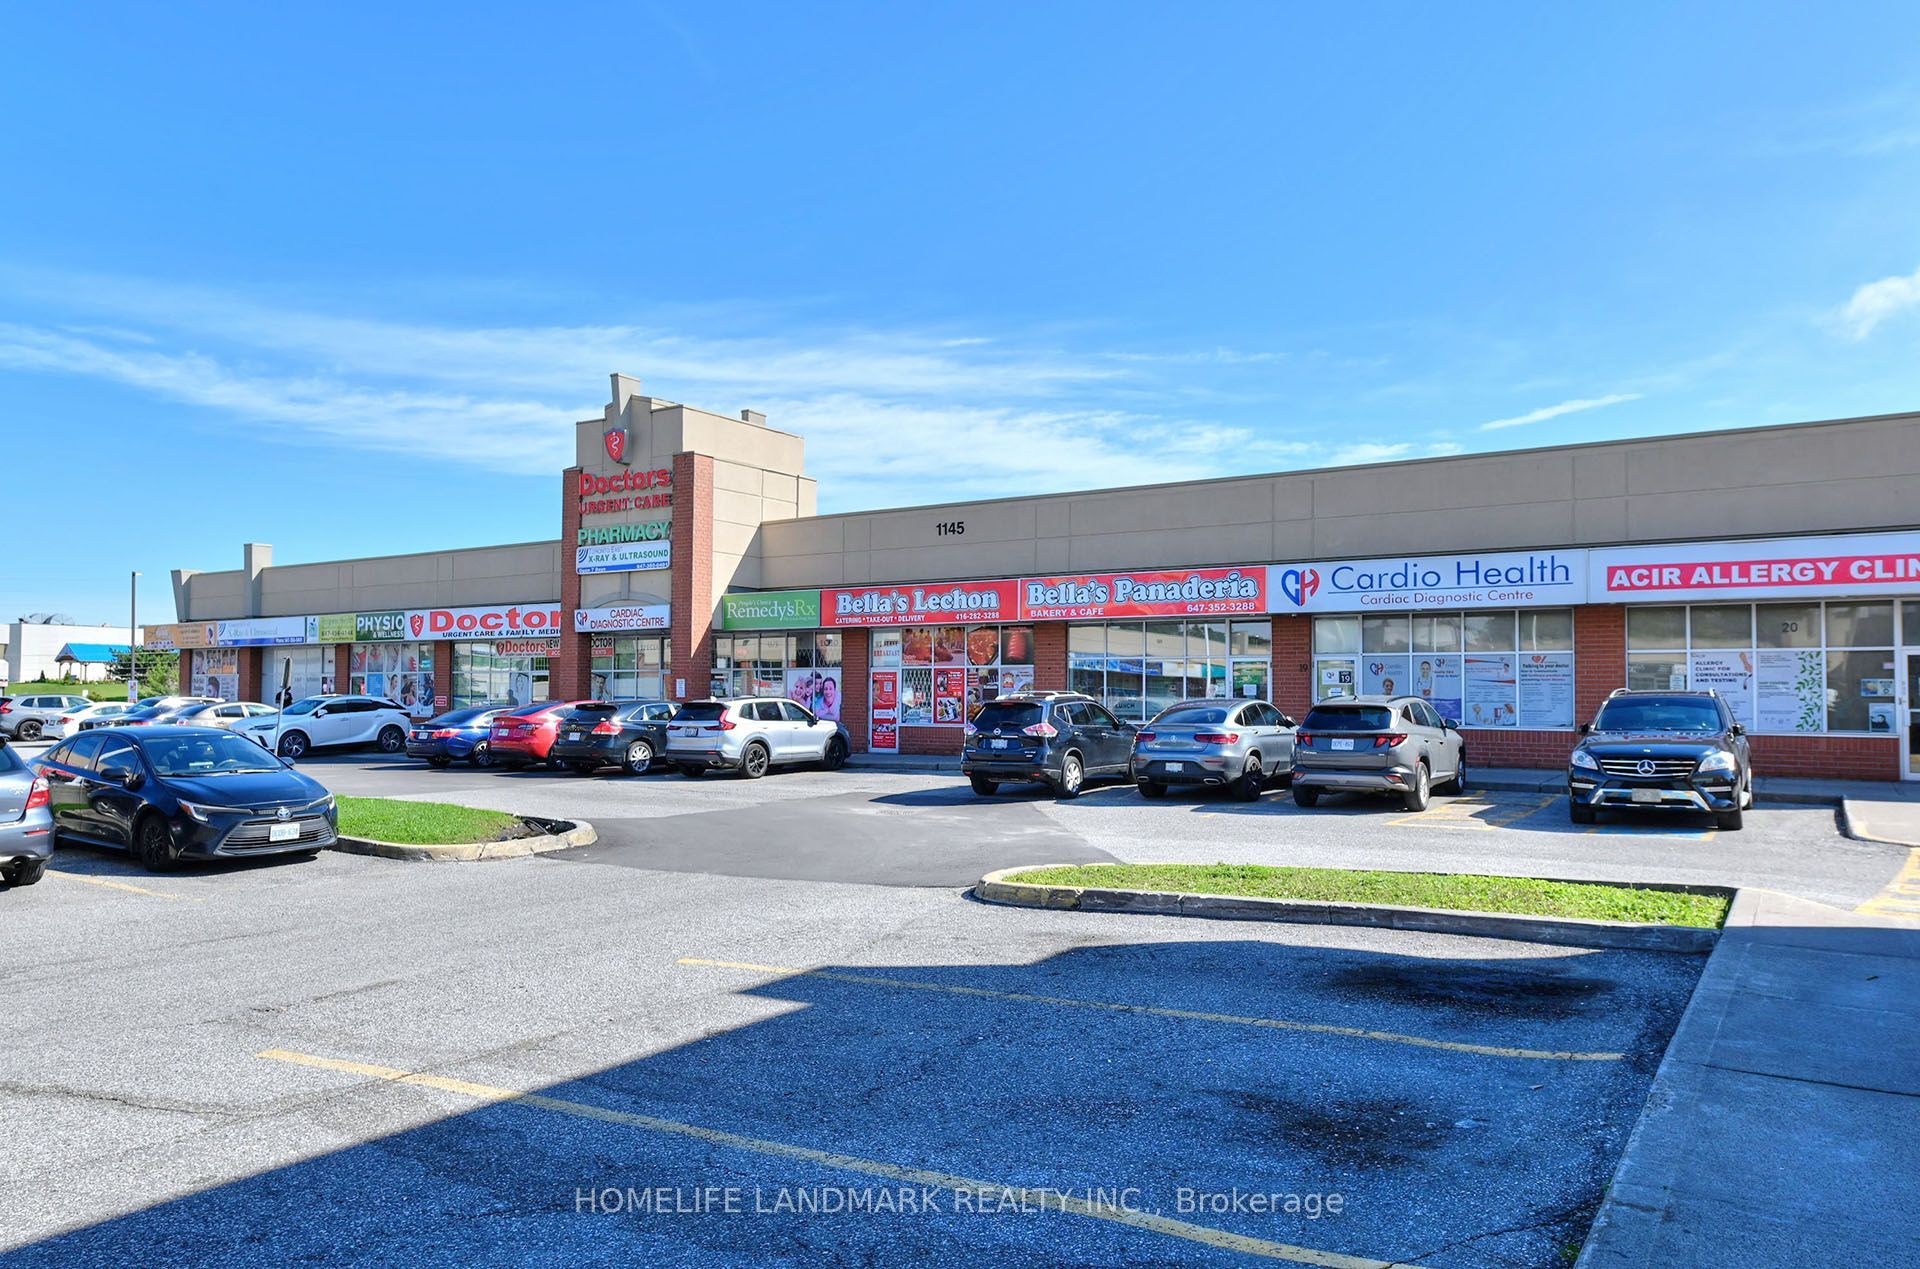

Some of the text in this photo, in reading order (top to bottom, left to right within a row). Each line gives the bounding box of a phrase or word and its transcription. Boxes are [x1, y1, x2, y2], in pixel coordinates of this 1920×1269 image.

[579, 468, 672, 496] Doctors
[579, 493, 671, 515] URGENT CARE
[577, 521, 671, 546] PHARMACY
[936, 521, 965, 536] 1145
[589, 554, 610, 563] X-RAY
[612, 552, 617, 560] &
[619, 549, 669, 561] ULTRASOUND
[1331, 562, 1441, 591] Cardio
[1456, 555, 1570, 586] Health
[1610, 558, 1920, 588] ACIR ALLERGY CLIN
[1026, 572, 1259, 606] Bella's Panaderia
[836, 587, 1000, 614] Bella's Lechon
[1360, 590, 1534, 605] Cardiac Diagnostic Centre
[610, 608, 644, 619] CARDIAC
[1030, 607, 1104, 617] BAKERY & CAFE
[1187, 602, 1255, 612] 647-352-3288
[356, 614, 405, 632] PHYSIO
[590, 615, 665, 629] DIAGNOSTIC CENTRE
[835, 615, 925, 625] CATERING TAKE-OUT DELIVERY
[955, 612, 1000, 620] 416-282-3288
[377, 630, 404, 638] WELLNESS
[1782, 622, 1798, 633] 20
[505, 640, 546, 653] Doctors
[1341, 675, 1351, 683] 19
